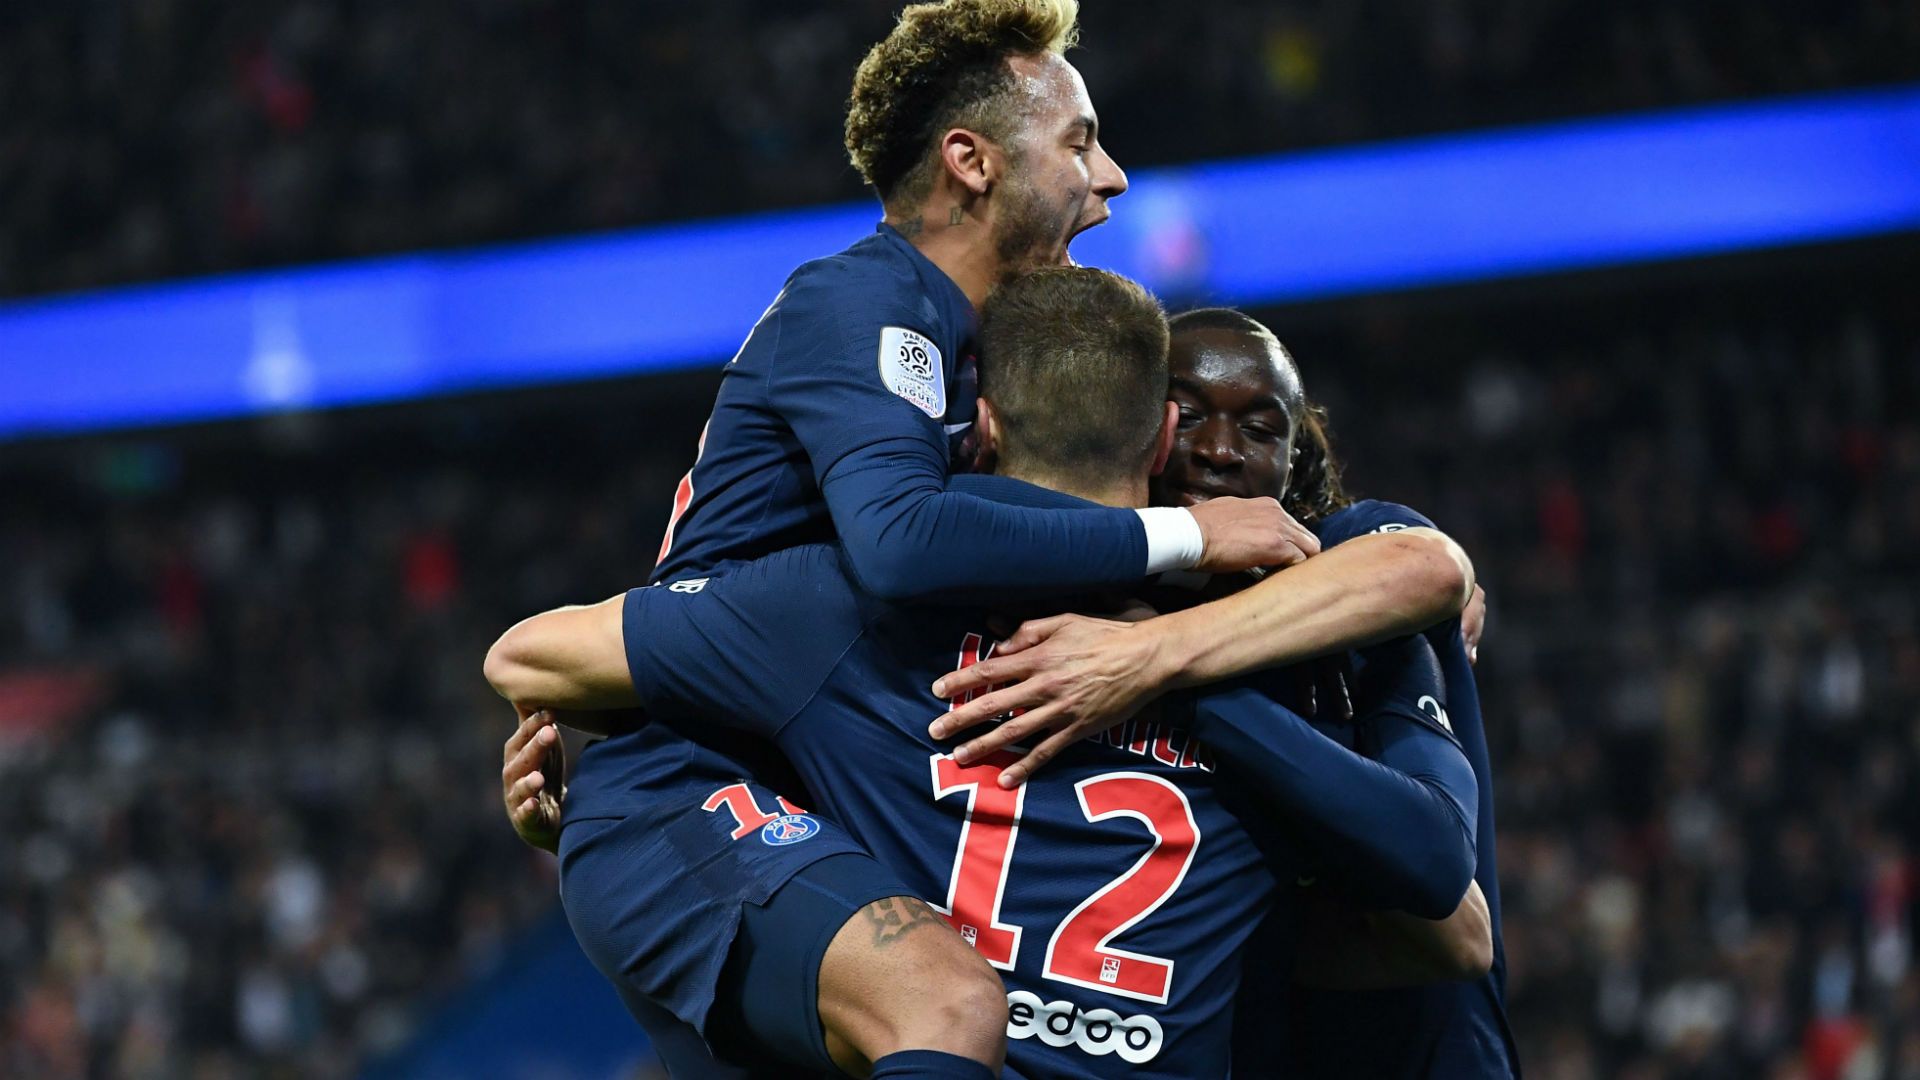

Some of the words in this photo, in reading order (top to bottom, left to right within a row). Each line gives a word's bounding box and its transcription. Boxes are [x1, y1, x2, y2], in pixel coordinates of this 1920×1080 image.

[902, 331, 928, 349] PARIS
[897, 385, 931, 405] LIGUE
[701, 783, 809, 841] 1
[765, 816, 802, 832] PARIS
[925, 743, 1201, 1005] 12
